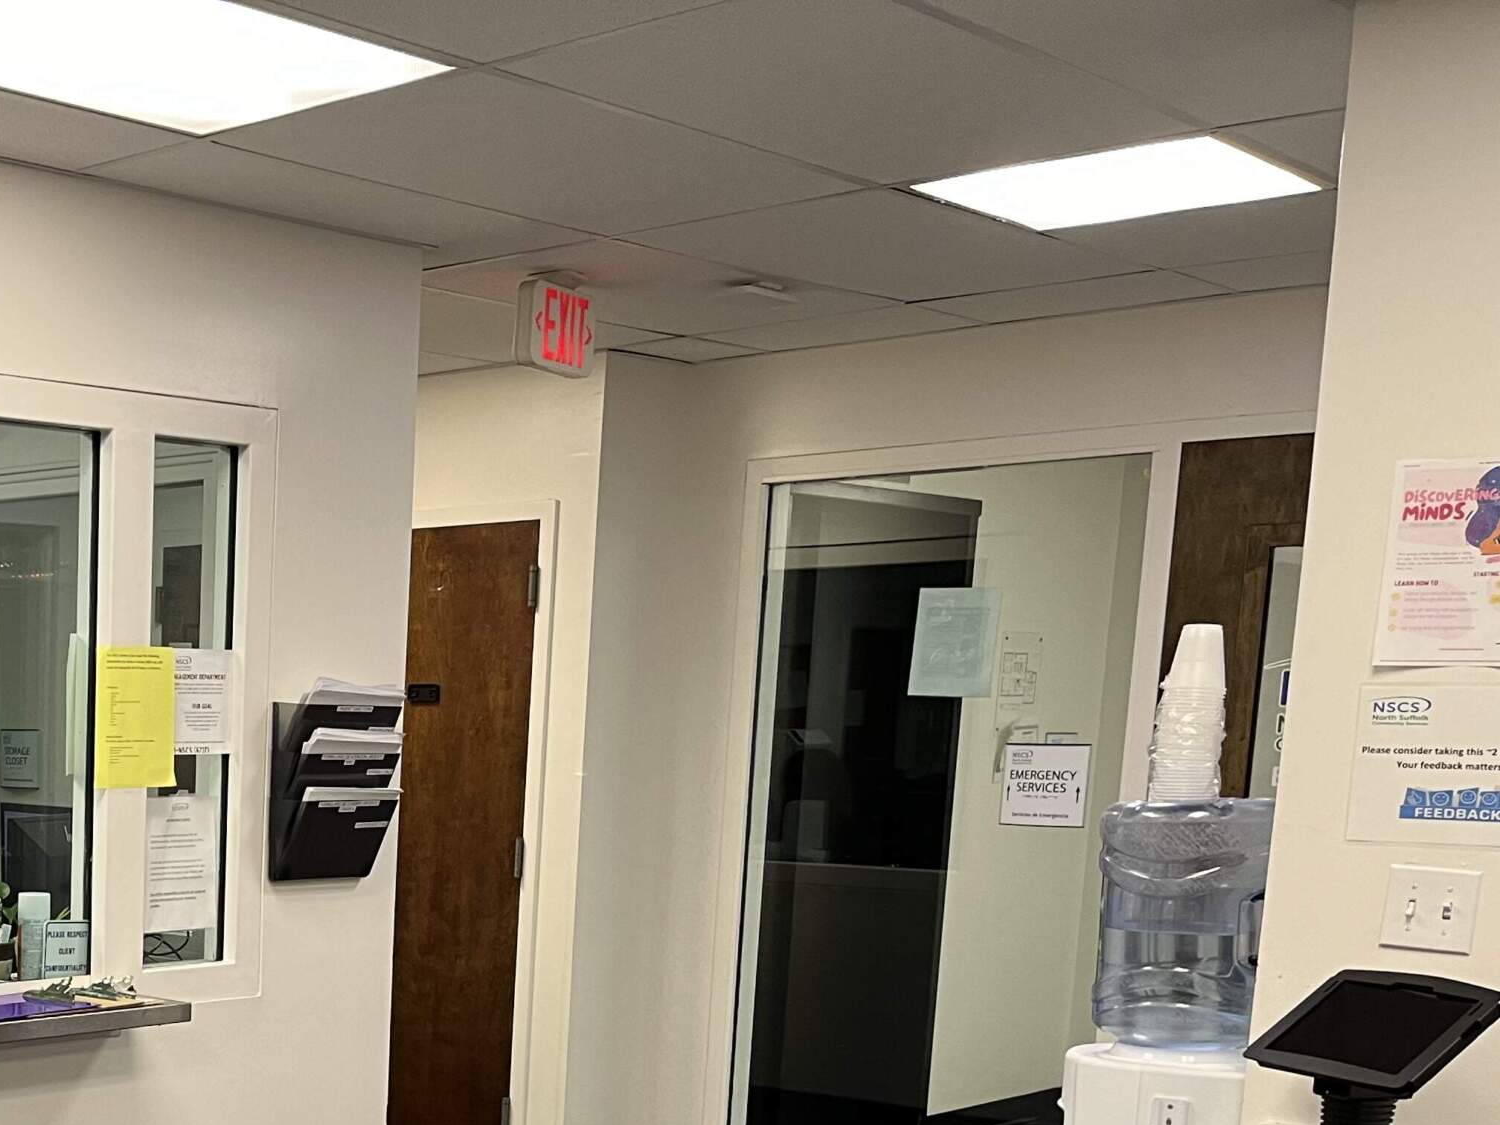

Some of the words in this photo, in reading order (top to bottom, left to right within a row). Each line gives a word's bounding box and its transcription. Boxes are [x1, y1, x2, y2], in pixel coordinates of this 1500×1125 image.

[542, 287, 590, 368] EXIT
[1373, 701, 1420, 713] NSCS
[1361, 746, 1391, 754] Please
[1393, 747, 1433, 755] consider
[1435, 748, 1464, 757] taking
[1466, 748, 1484, 756] this
[1396, 761, 1418, 769] Your
[1420, 761, 1462, 770] feedback
[1010, 769, 1077, 781] EMERGENCY
[1016, 782, 1067, 793] SERVICES
[1414, 807, 1500, 821] FEEDBACK
